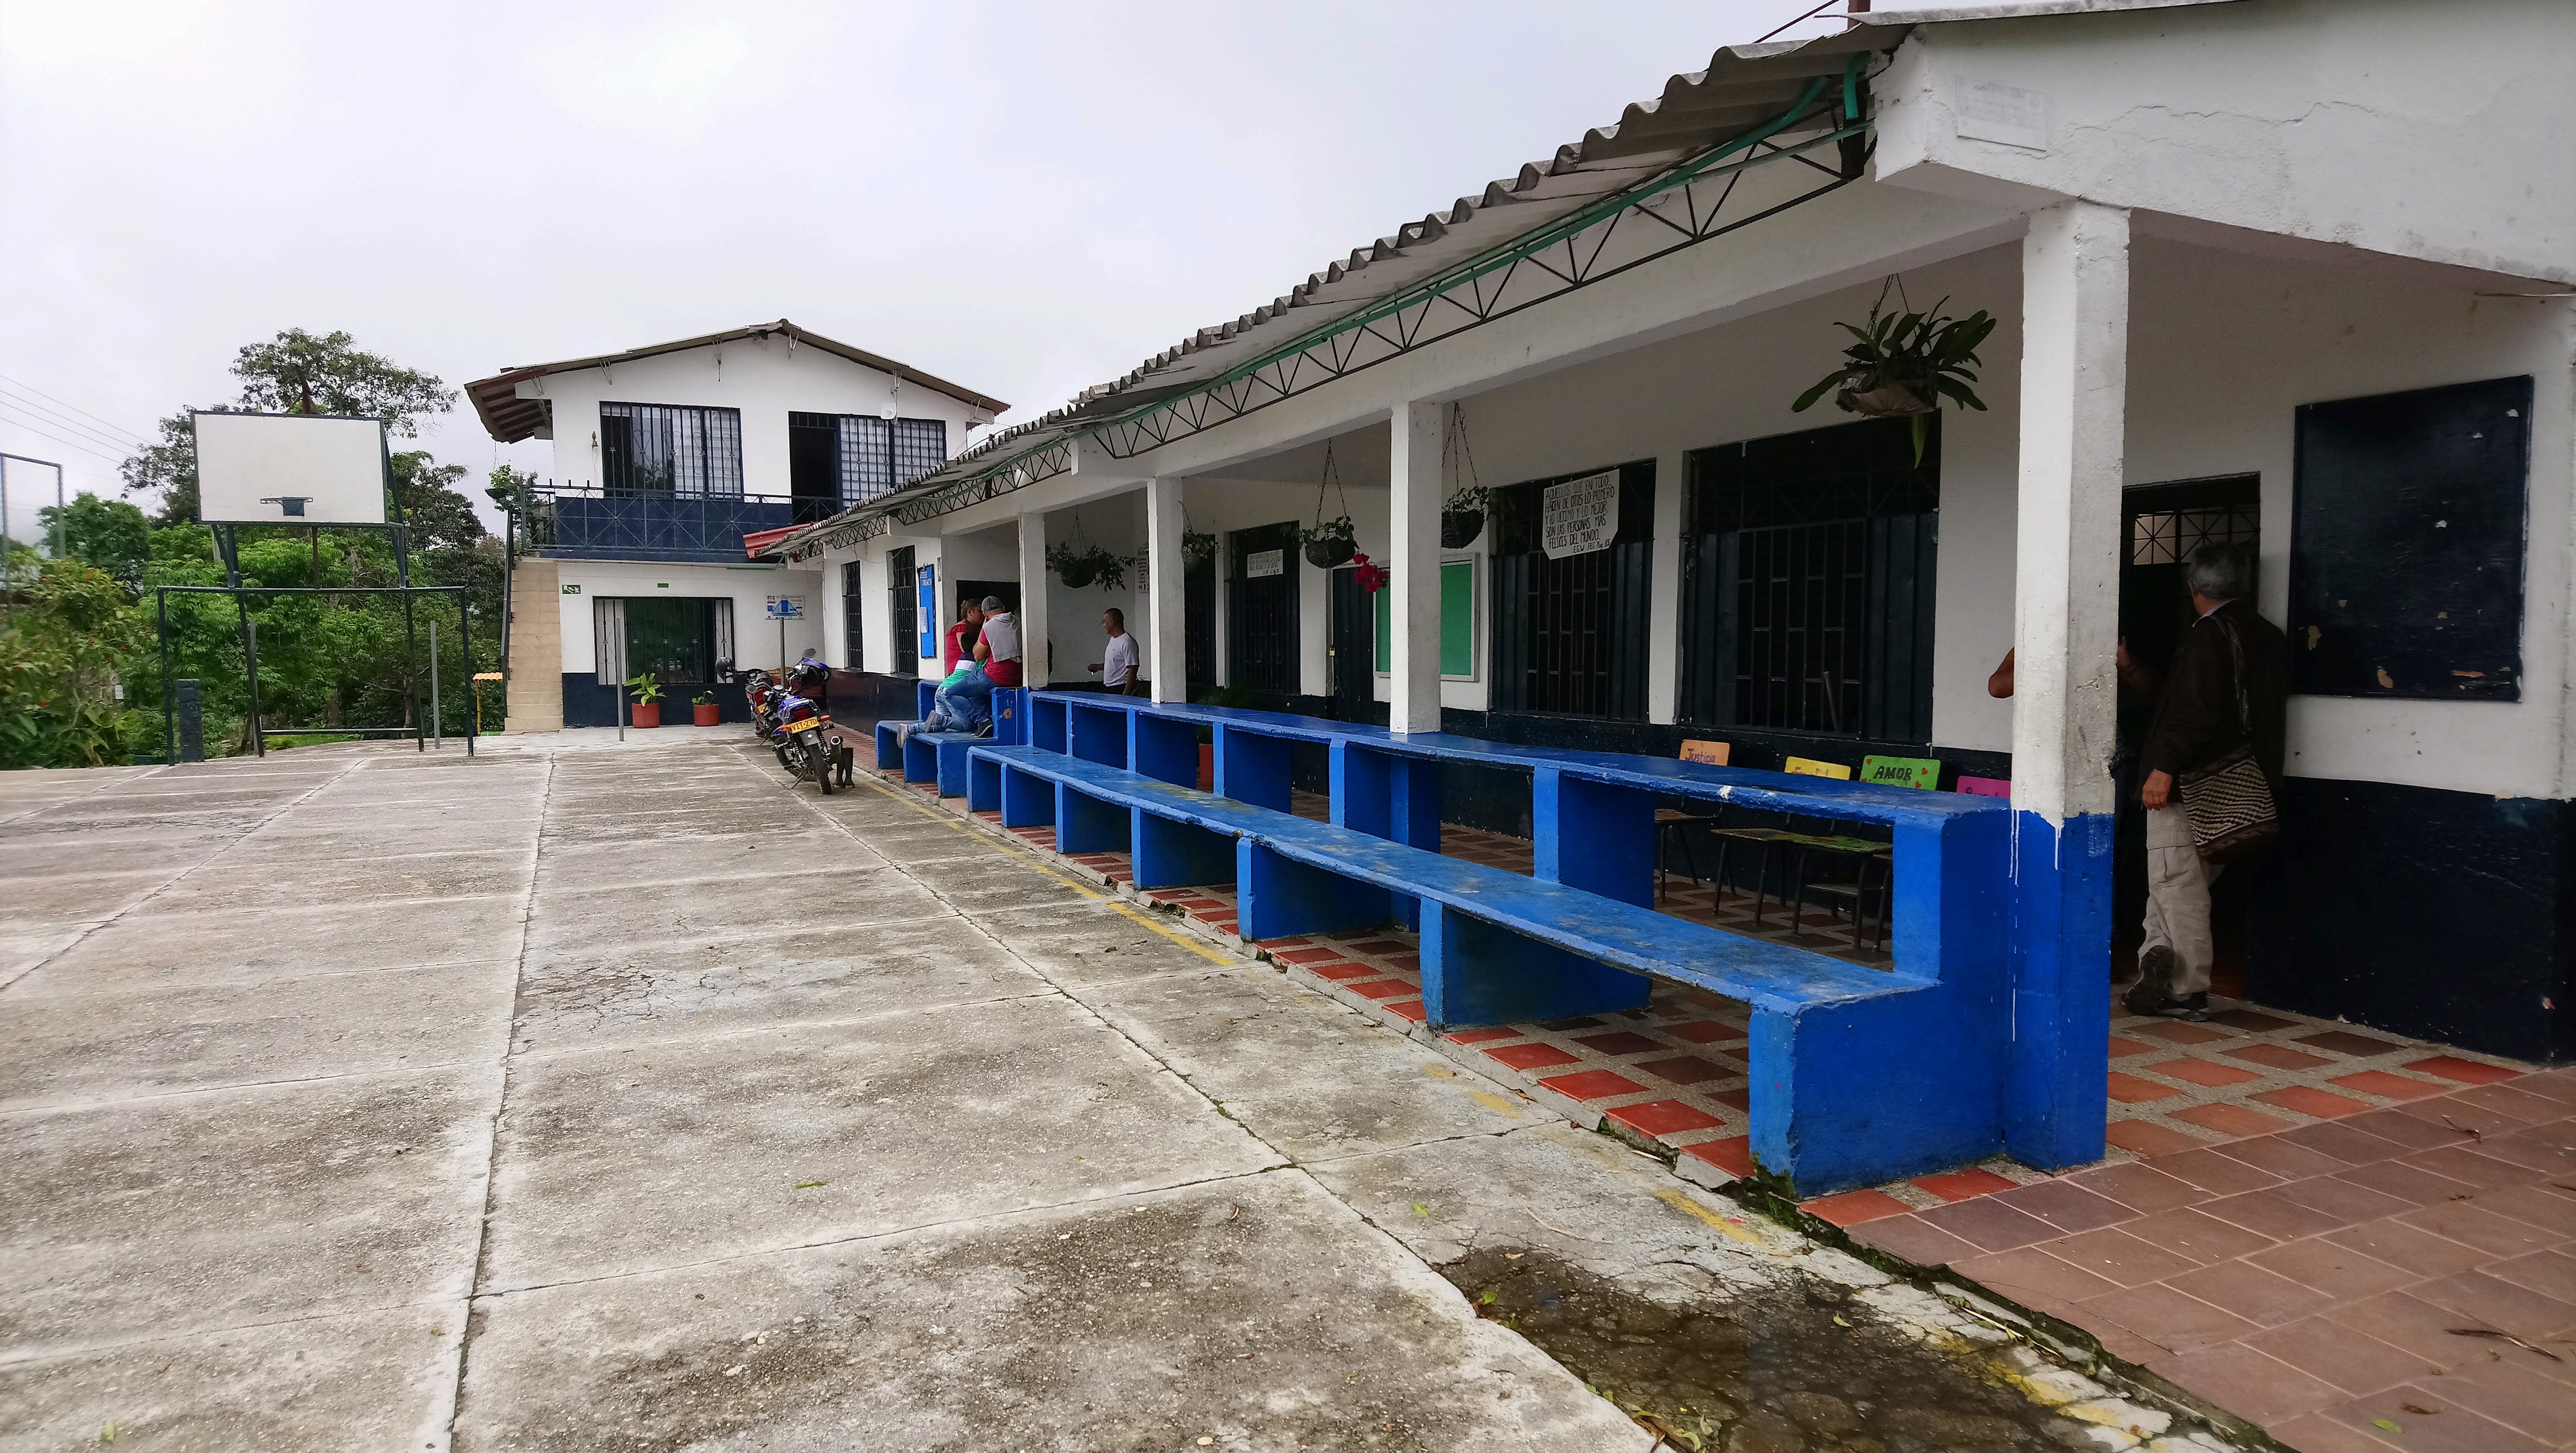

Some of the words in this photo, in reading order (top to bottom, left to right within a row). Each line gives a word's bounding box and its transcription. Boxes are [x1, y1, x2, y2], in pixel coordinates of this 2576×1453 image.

[1546, 485, 1570, 500] AQUELLOS
[1574, 482, 1583, 494] QUE
[1586, 480, 1593, 491] EN
[1546, 499, 1560, 513] HACEN
[1563, 497, 1568, 509] DE
[1571, 493, 1583, 508] DIOS
[1584, 491, 1591, 504] LO
[1593, 486, 1615, 502] PRIMERO
[1545, 515, 1549, 525] Y
[1550, 513, 1555, 525] LO
[1557, 509, 1574, 523] ULTIMO
[1576, 507, 1580, 519] Y
[1582, 505, 1588, 518] LO
[1546, 526, 1556, 538] SON
[1567, 518, 1591, 533] PERSONAS
[1595, 514, 1606, 527] MAS
[1549, 535, 1567, 549] FELICES
[1570, 533, 1578, 546] DEL
[1685, 748, 1716, 764] Justicia
[1873, 765, 1912, 781] AMOR
